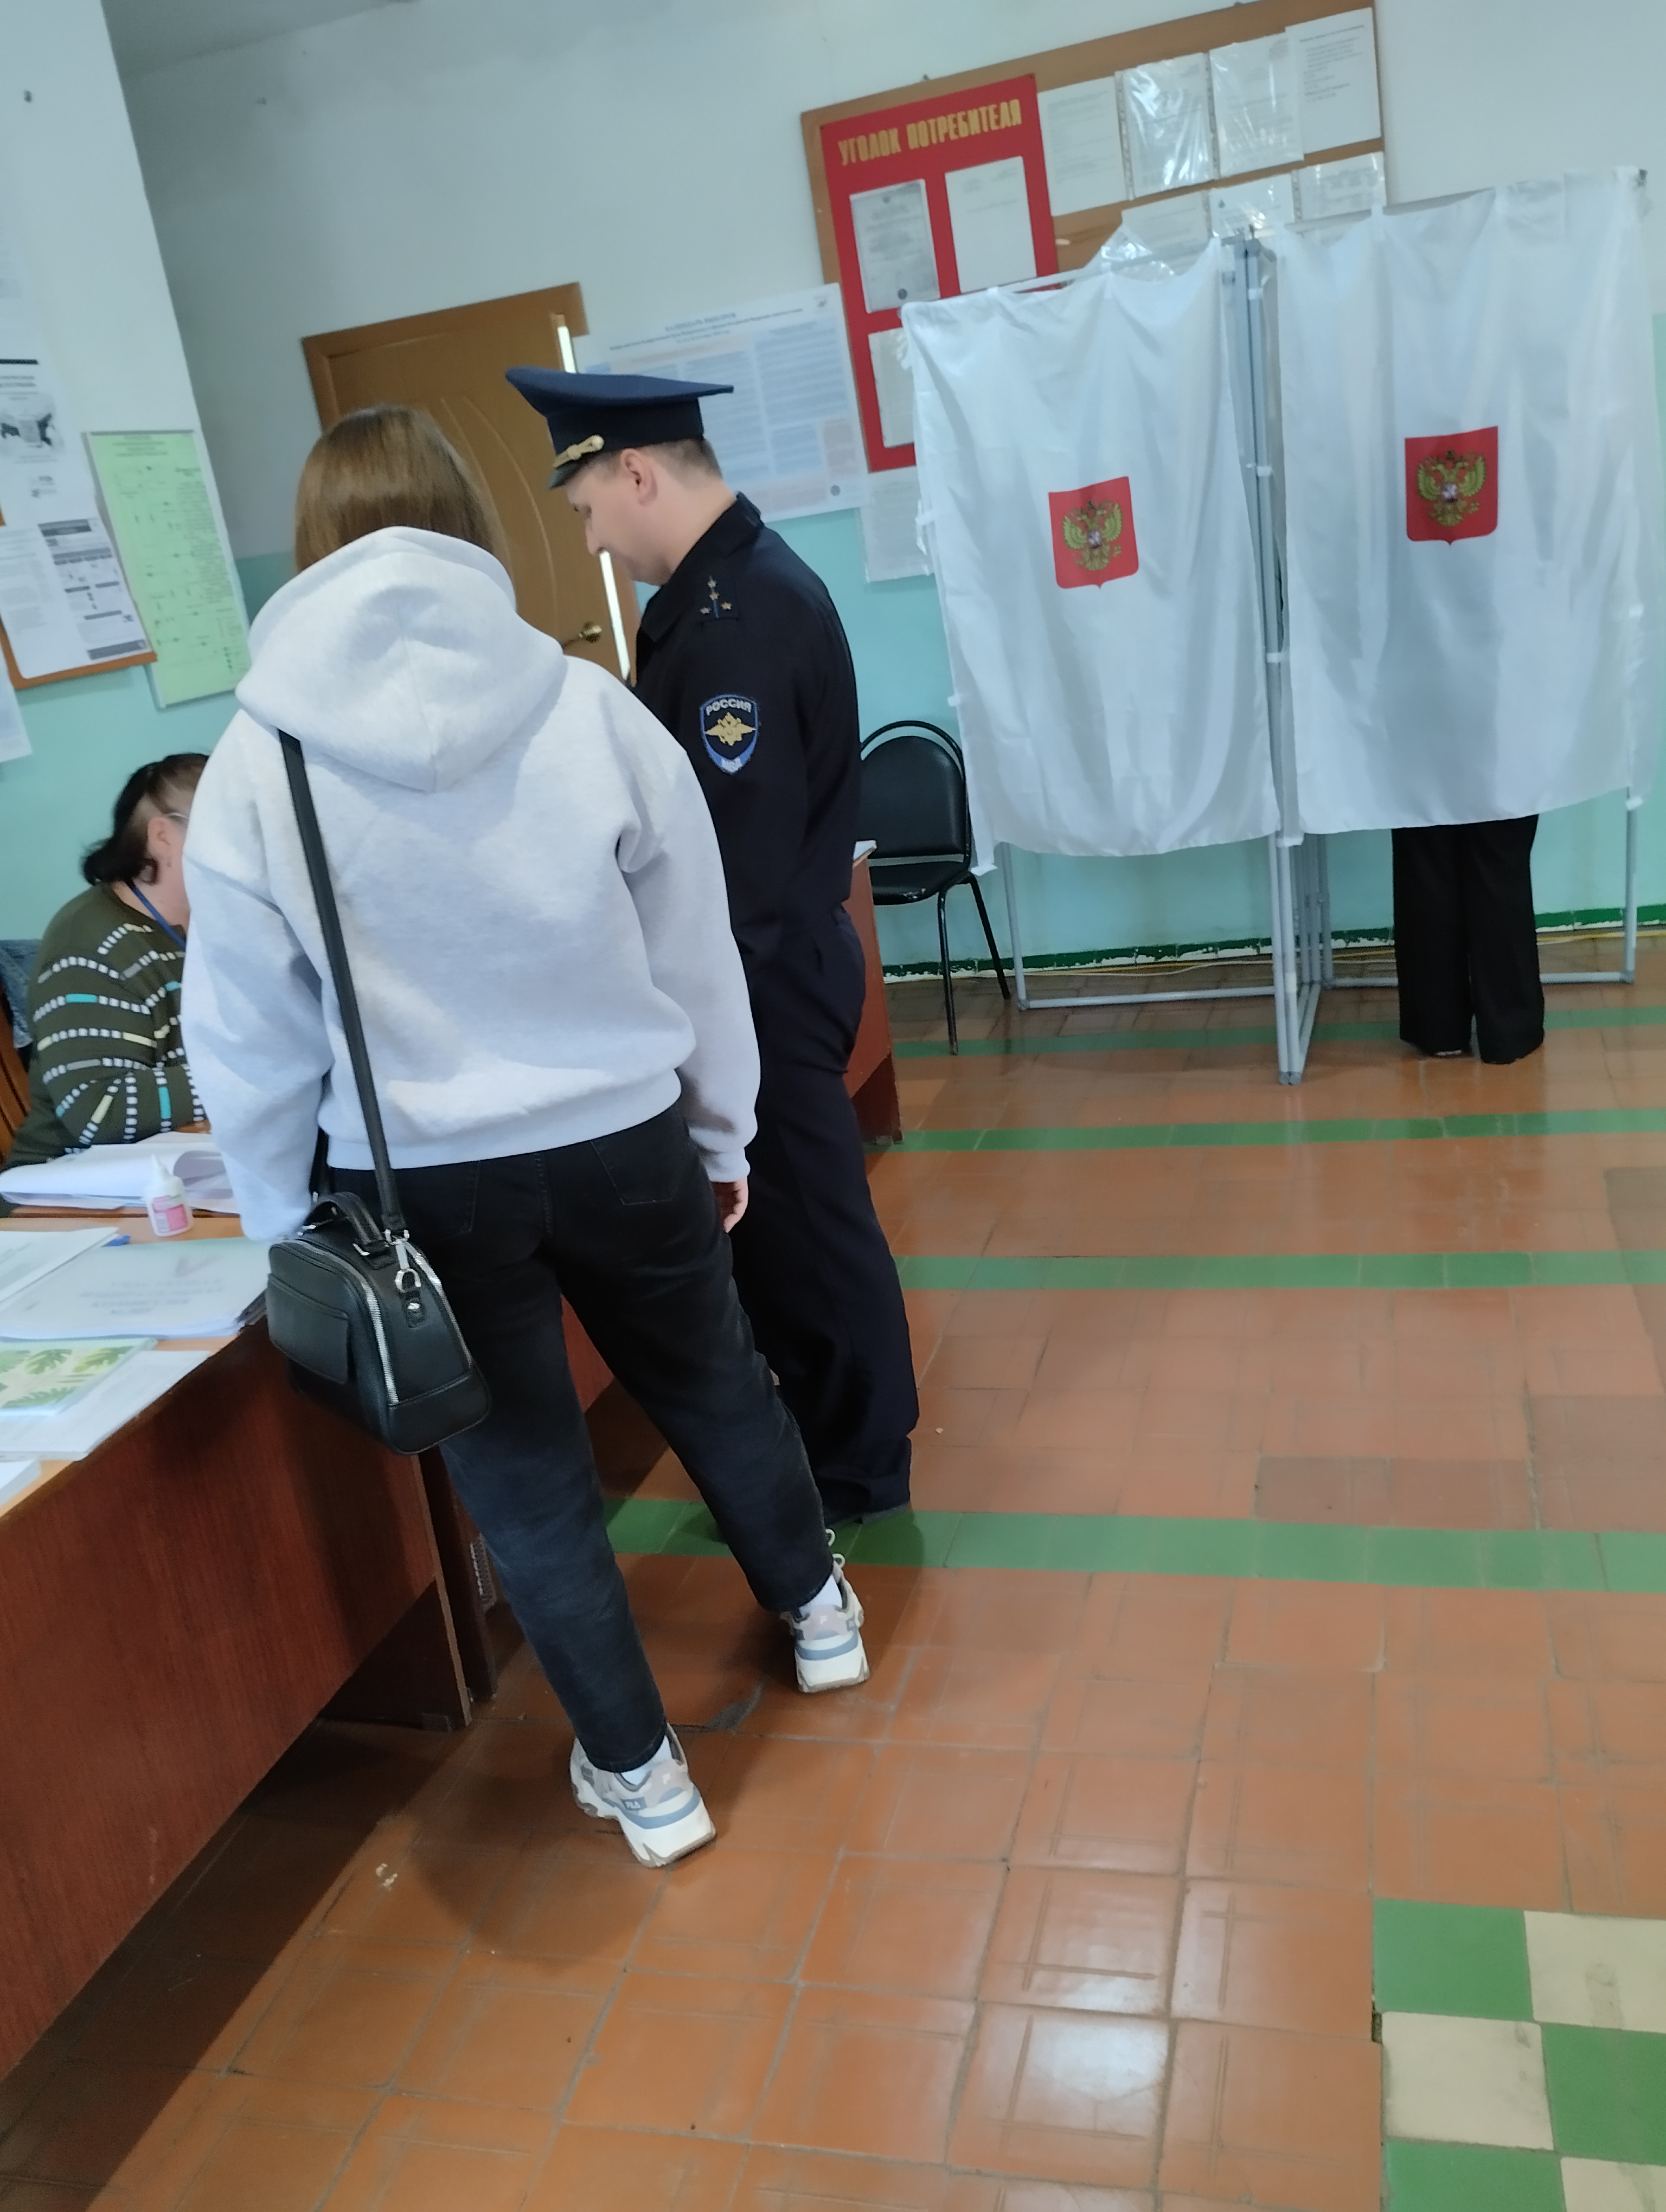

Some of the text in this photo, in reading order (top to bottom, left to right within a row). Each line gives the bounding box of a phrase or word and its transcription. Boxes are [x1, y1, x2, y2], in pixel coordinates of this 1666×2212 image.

[838, 128, 901, 166] УГОЛОК
[906, 99, 1022, 150] ПОТРЕБИТЕЛЯ
[706, 698, 752, 716] РОССИЯ
